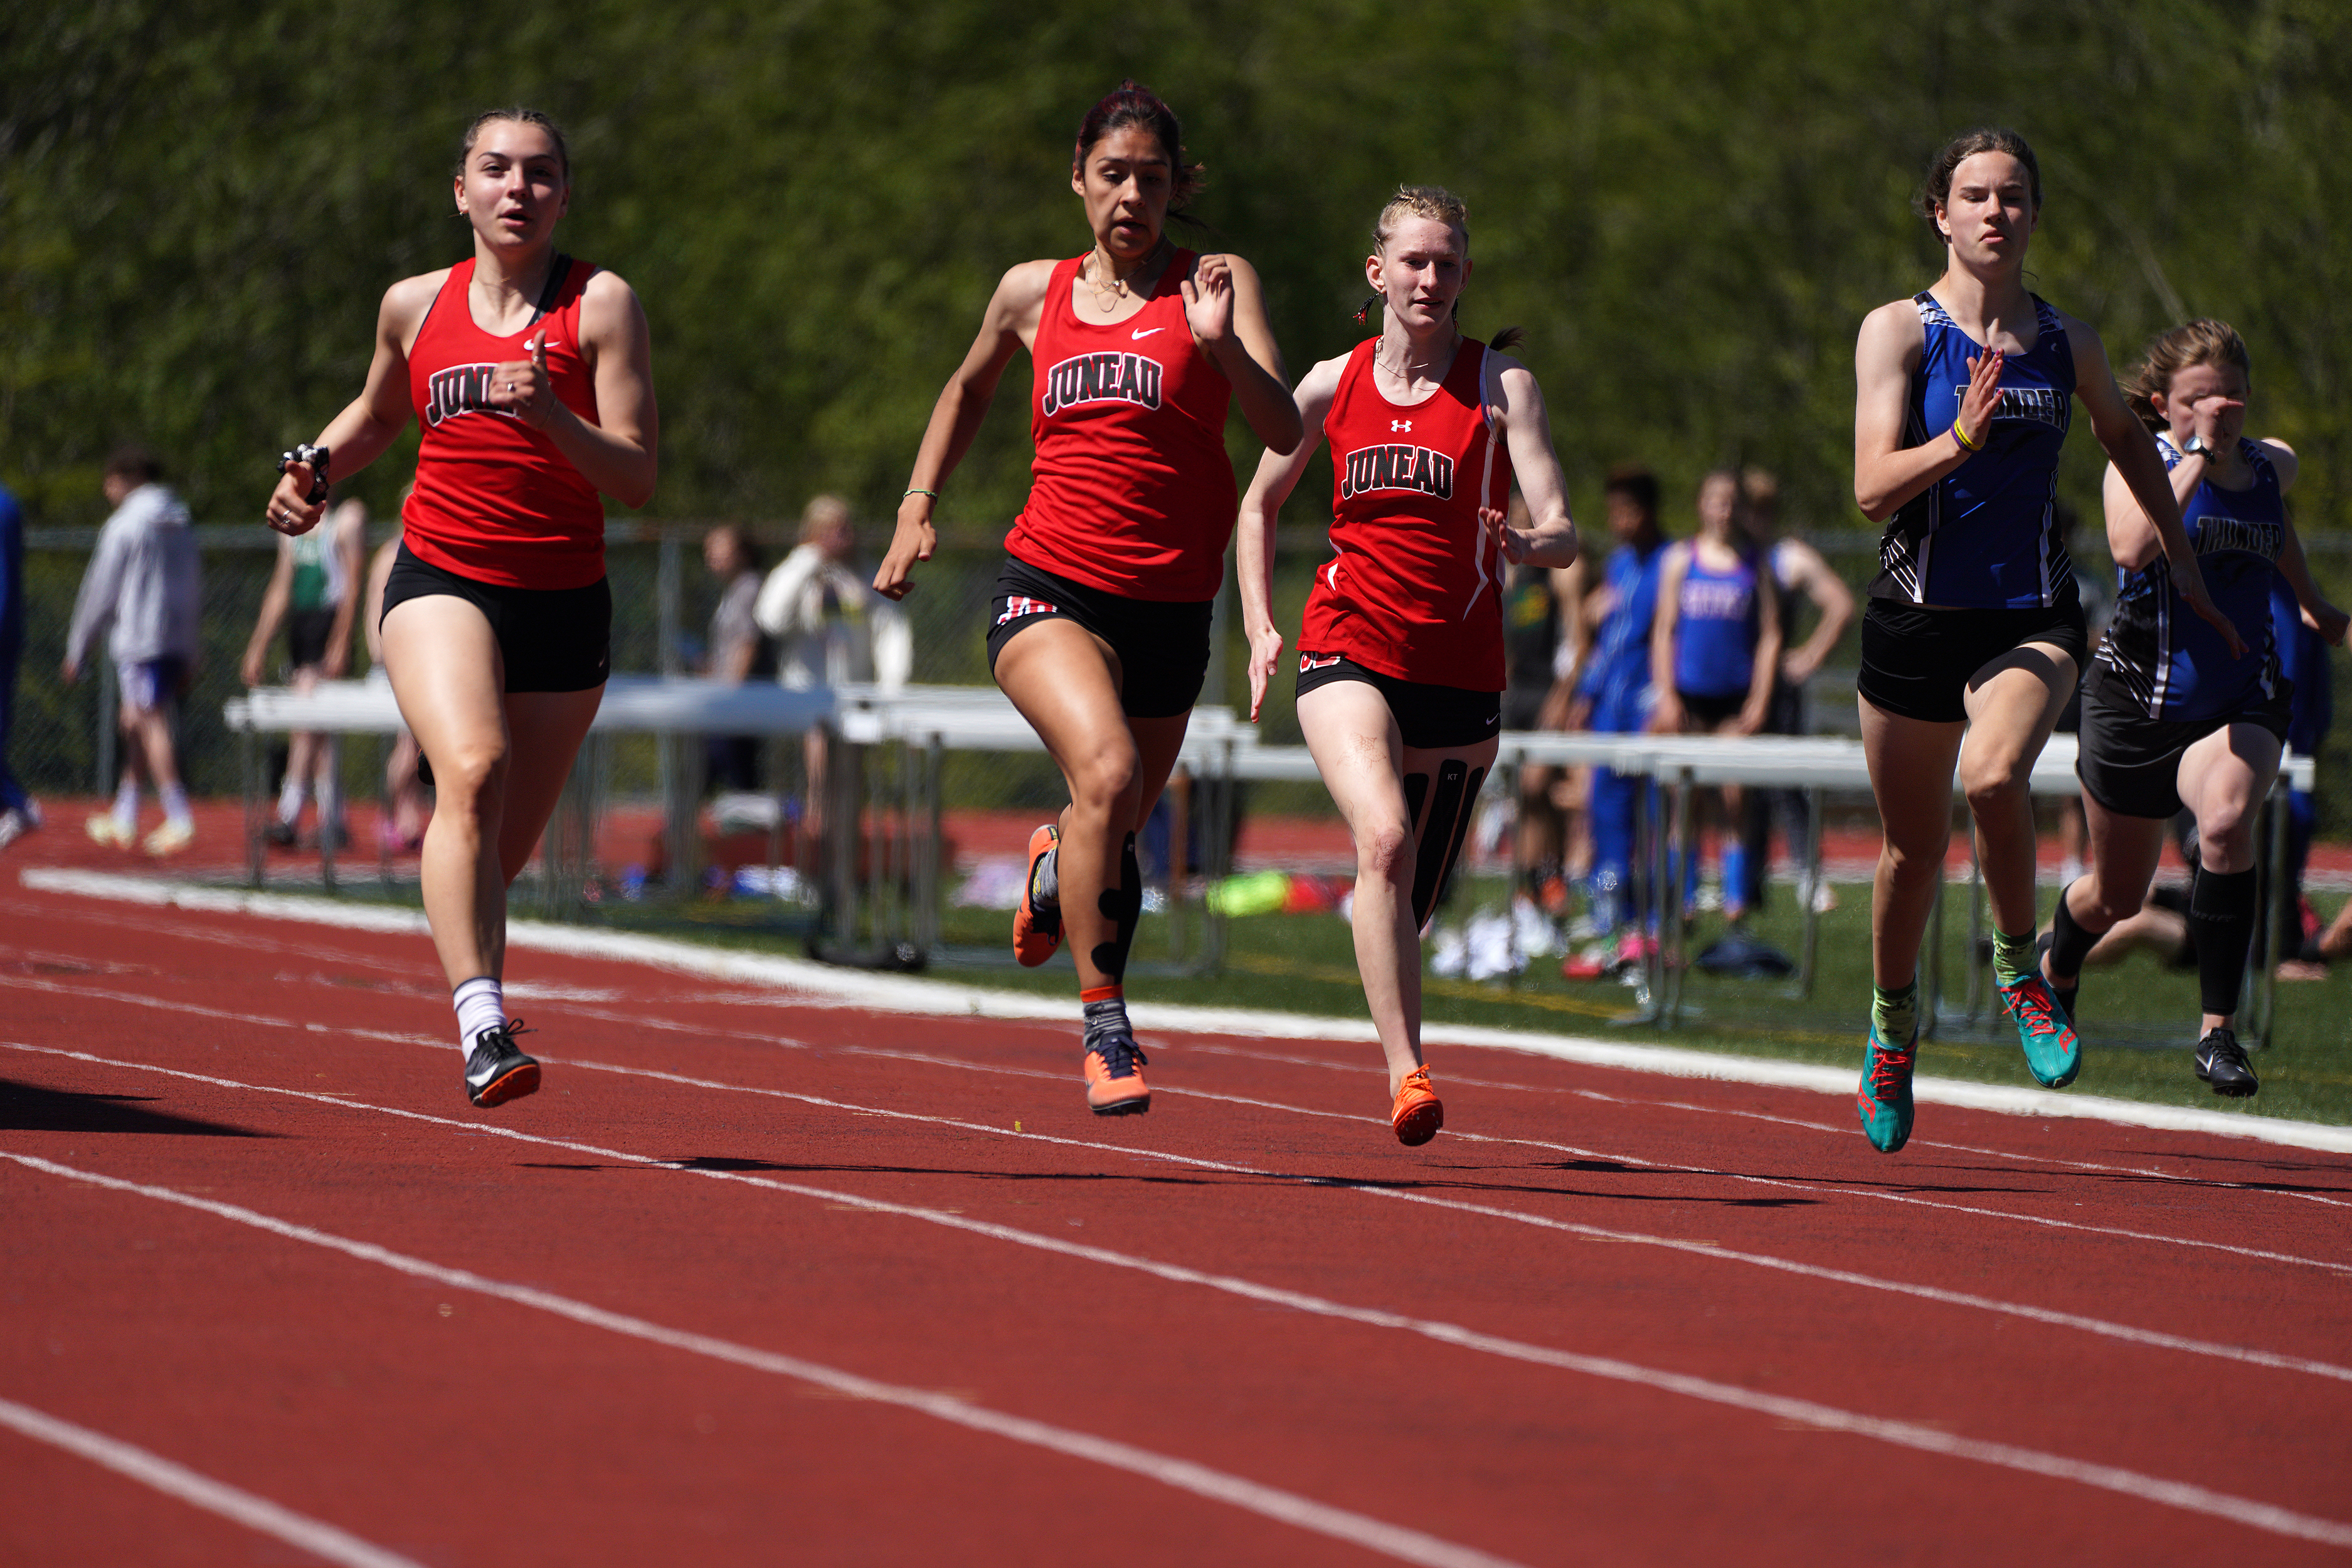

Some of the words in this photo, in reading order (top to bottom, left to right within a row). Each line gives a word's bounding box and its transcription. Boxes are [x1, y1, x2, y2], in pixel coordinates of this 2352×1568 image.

[1042, 351, 1163, 417] JUNEAU
[1341, 443, 1454, 501] JUNEAU
[2196, 516, 2282, 563] THUNDER
